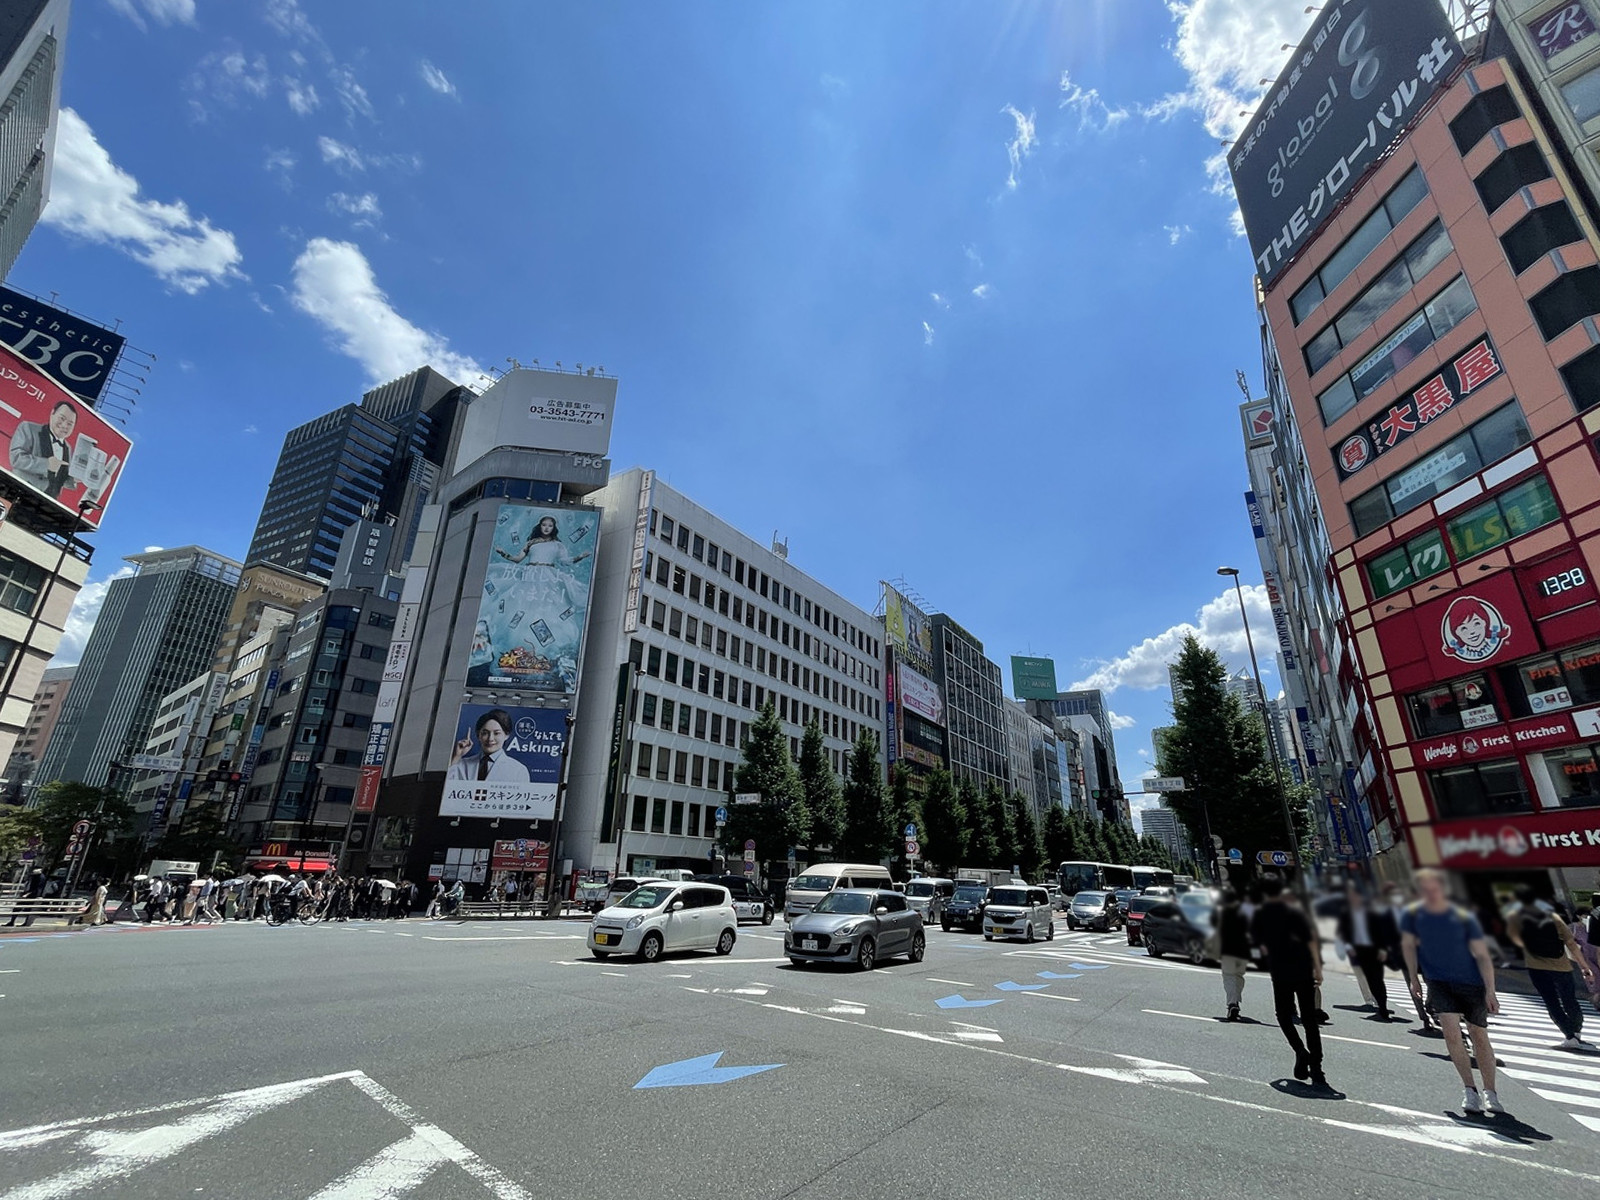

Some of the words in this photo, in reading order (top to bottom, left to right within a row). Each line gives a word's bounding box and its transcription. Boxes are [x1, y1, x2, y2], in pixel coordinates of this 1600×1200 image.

[1267, 76, 1338, 197] global
[1257, 36, 1454, 275] THEグローバル社
[2, 303, 113, 353] esthetic
[546, 400, 591, 410] 広告募集中
[1380, 340, 1500, 447] 大黒屋
[530, 406, 605, 420] 03-3543-7771
[573, 457, 603, 469] FPG
[1273, 607, 1287, 649] SHINJUKU
[364, 723, 382, 765] 矯正歯科
[506, 736, 565, 757] Asking!
[1424, 742, 1457, 762] Wendy's
[1482, 735, 1511, 748] First
[1515, 725, 1566, 742] Kitchen
[448, 790, 472, 800] AGA
[489, 791, 556, 803] スキンクリニック
[1529, 831, 1582, 848] First
[1272, 853, 1286, 862] 414
